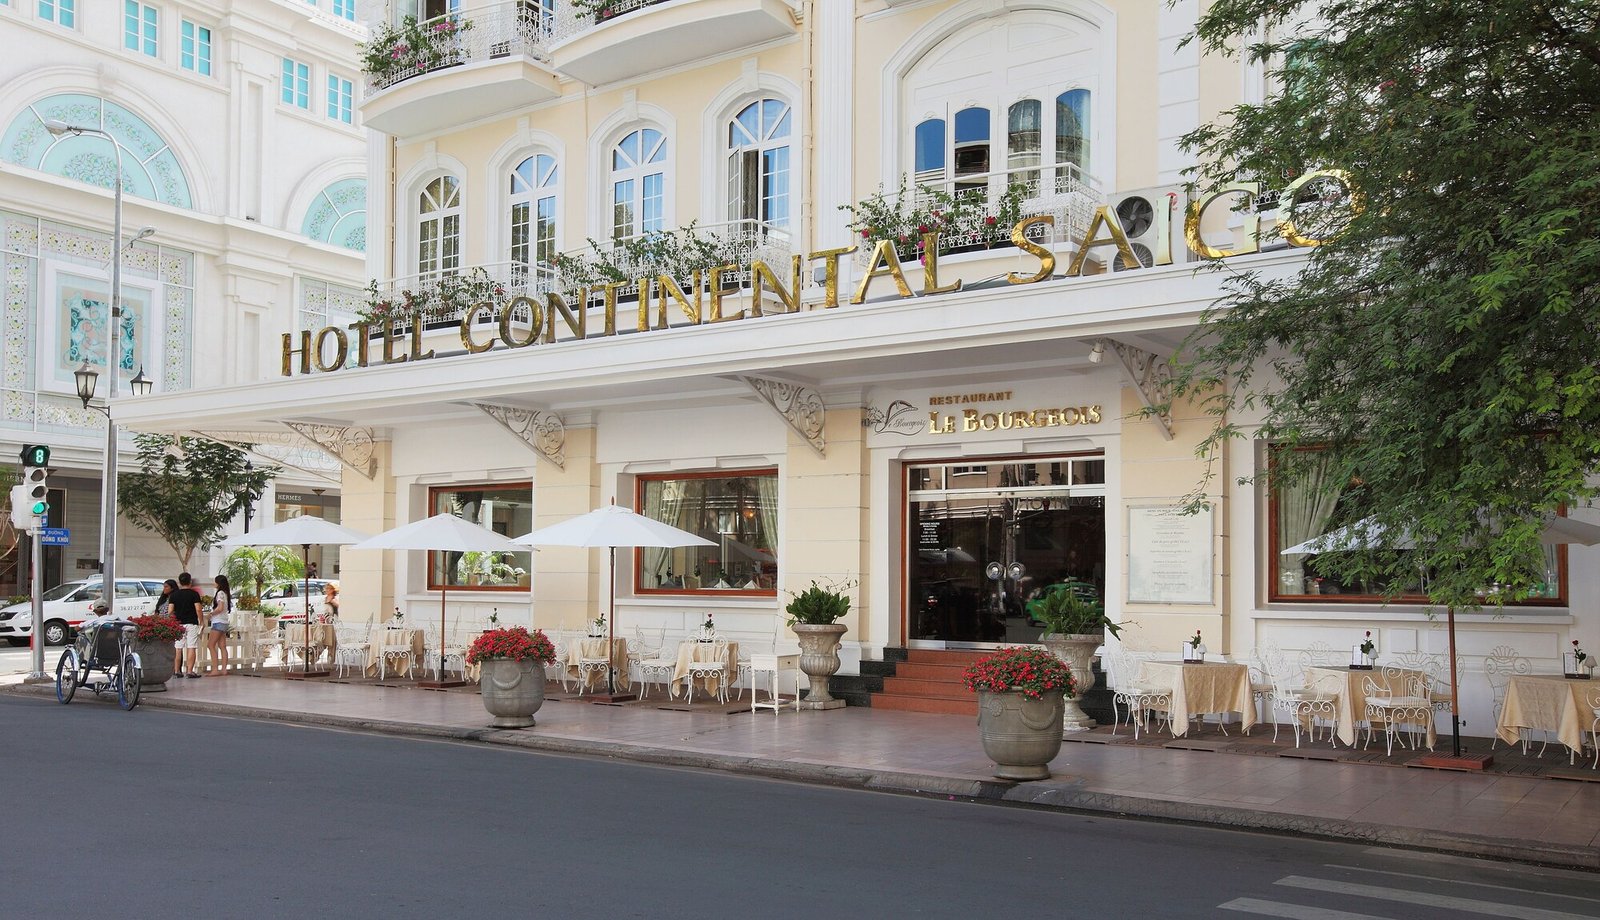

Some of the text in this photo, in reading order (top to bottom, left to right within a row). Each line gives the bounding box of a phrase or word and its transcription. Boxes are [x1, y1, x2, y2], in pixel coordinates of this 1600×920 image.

[281, 169, 1392, 377] HOTEL CONTINENTAL SAIGO
[929, 391, 1012, 405] RESTAURANT
[35, 449, 44, 464] 8
